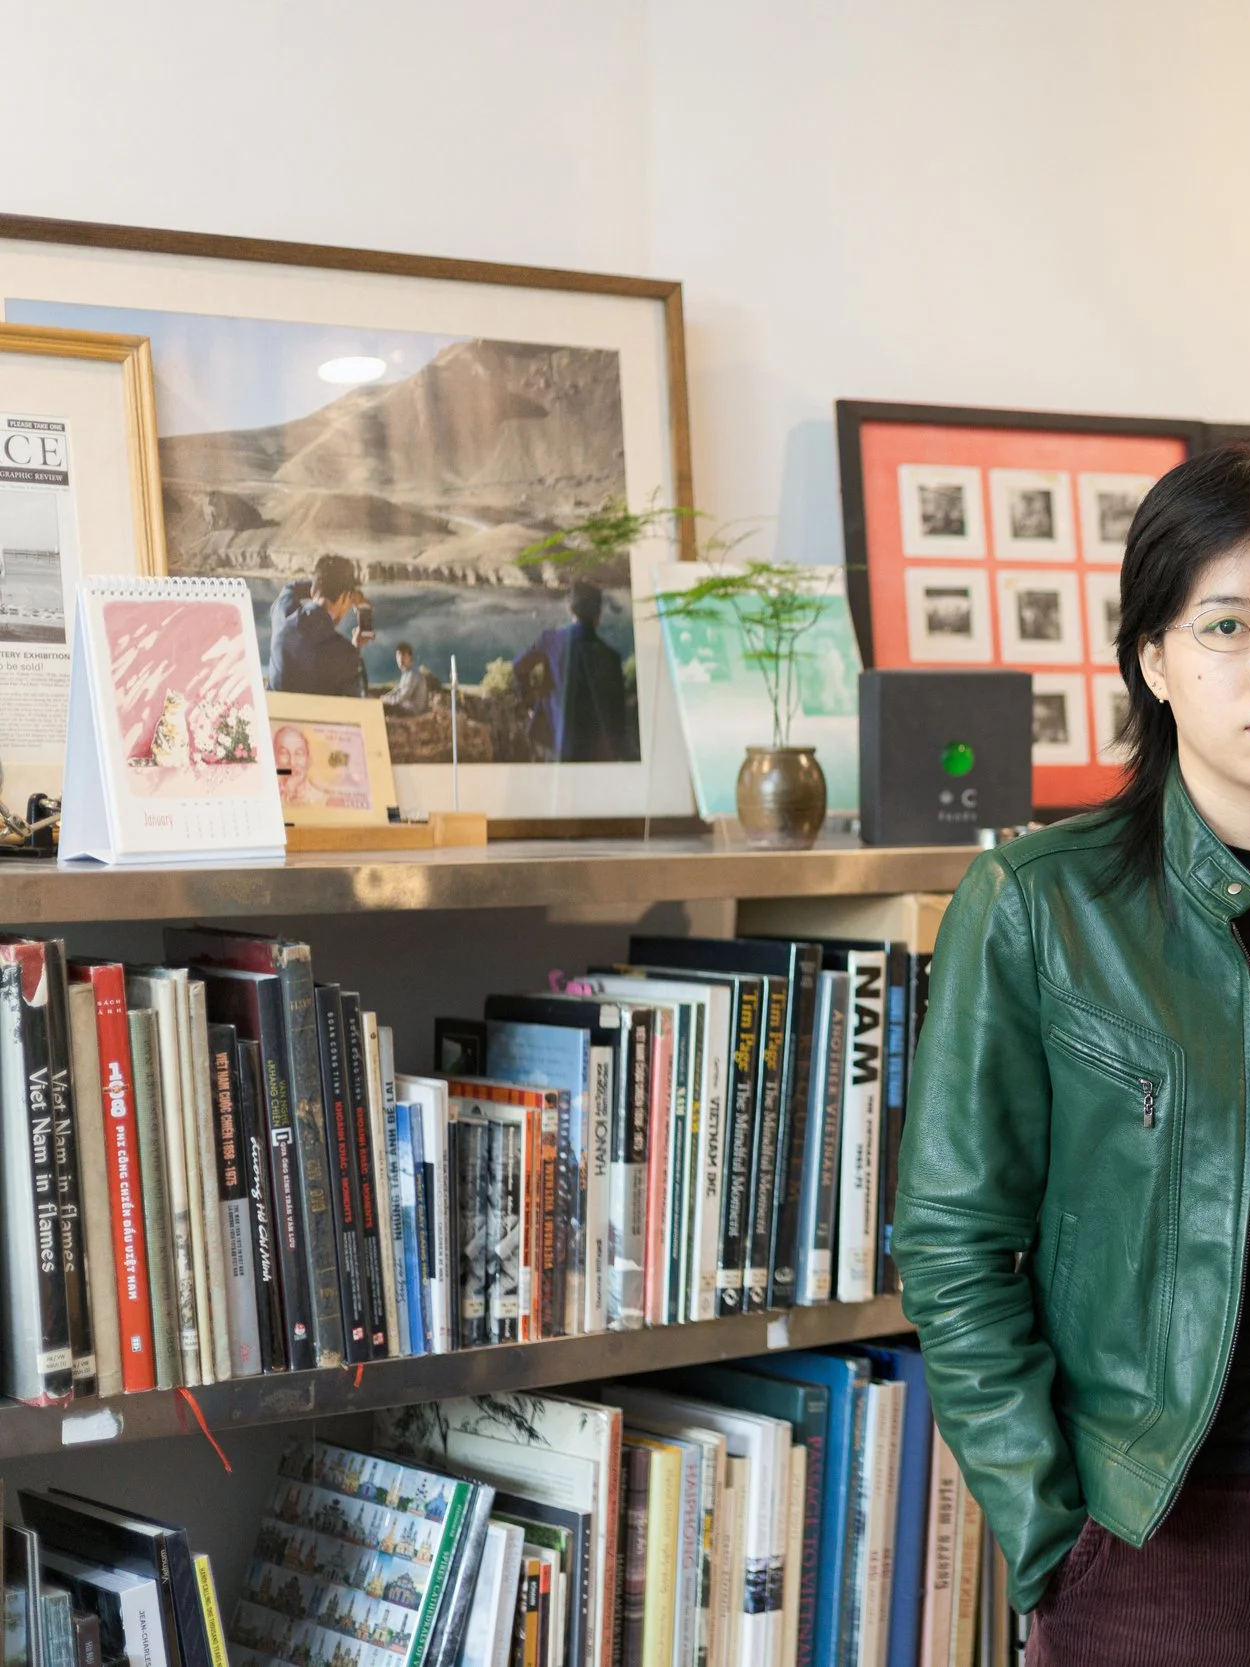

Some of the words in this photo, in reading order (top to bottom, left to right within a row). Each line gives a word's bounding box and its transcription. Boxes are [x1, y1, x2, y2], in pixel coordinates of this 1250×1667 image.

[9, 420, 33, 429] PLEASE
[33, 422, 49, 430] TAKE
[49, 423, 63, 431] ONE
[34, 473, 63, 481] REVIEW
[6, 662, 18, 671] be
[20, 663, 44, 671] sold!
[24, 652, 70, 660] EXHIBITION
[144, 810, 174, 830] January
[740, 991, 757, 1028] Tim
[769, 992, 786, 1027] Tim
[852, 966, 882, 1085] NAM
[734, 1032, 755, 1072] Page
[764, 1032, 784, 1071] Page
[828, 1009, 844, 1095] ANOTHER
[29, 1067, 48, 1111] Viet
[52, 1069, 68, 1112] Viet
[108, 1062, 127, 1118] 108
[217, 1070, 230, 1090] NAM
[736, 1080, 750, 1110] The
[765, 1080, 778, 1108] The
[31, 1117, 52, 1164] Nam
[54, 1118, 72, 1164] Nam
[116, 1125, 125, 1146] PHI
[222, 1140, 235, 1160] 1858
[280, 1141, 288, 1156] QUA
[595, 1120, 609, 1176] HANOI
[707, 1096, 721, 1168] VIETNAM
[732, 1113, 750, 1173] Mindful
[761, 1111, 778, 1170] Mindful
[821, 1103, 836, 1186] VIETNAM
[36, 1174, 51, 1193] in
[117, 1151, 129, 1178] CÔNG
[224, 1166, 238, 1186] 1975
[58, 1175, 72, 1193] in
[341, 1177, 352, 1224] MOMENTS
[361, 1182, 373, 1229] MOMENTS
[728, 1175, 746, 1237] Moment
[756, 1172, 773, 1235] Moment
[38, 1202, 58, 1273] flames
[61, 1203, 78, 1273] flames
[123, 1246, 136, 1273] VIỆT
[259, 1248, 272, 1282] Minh
[127, 1276, 139, 1301] NAM
[801, 1536, 817, 1565] TO
[421, 1585, 440, 1643] CATHEDRALS
[139, 1610, 152, 1667] JEAN-CHARLES
[416, 1645, 424, 1656] OF
